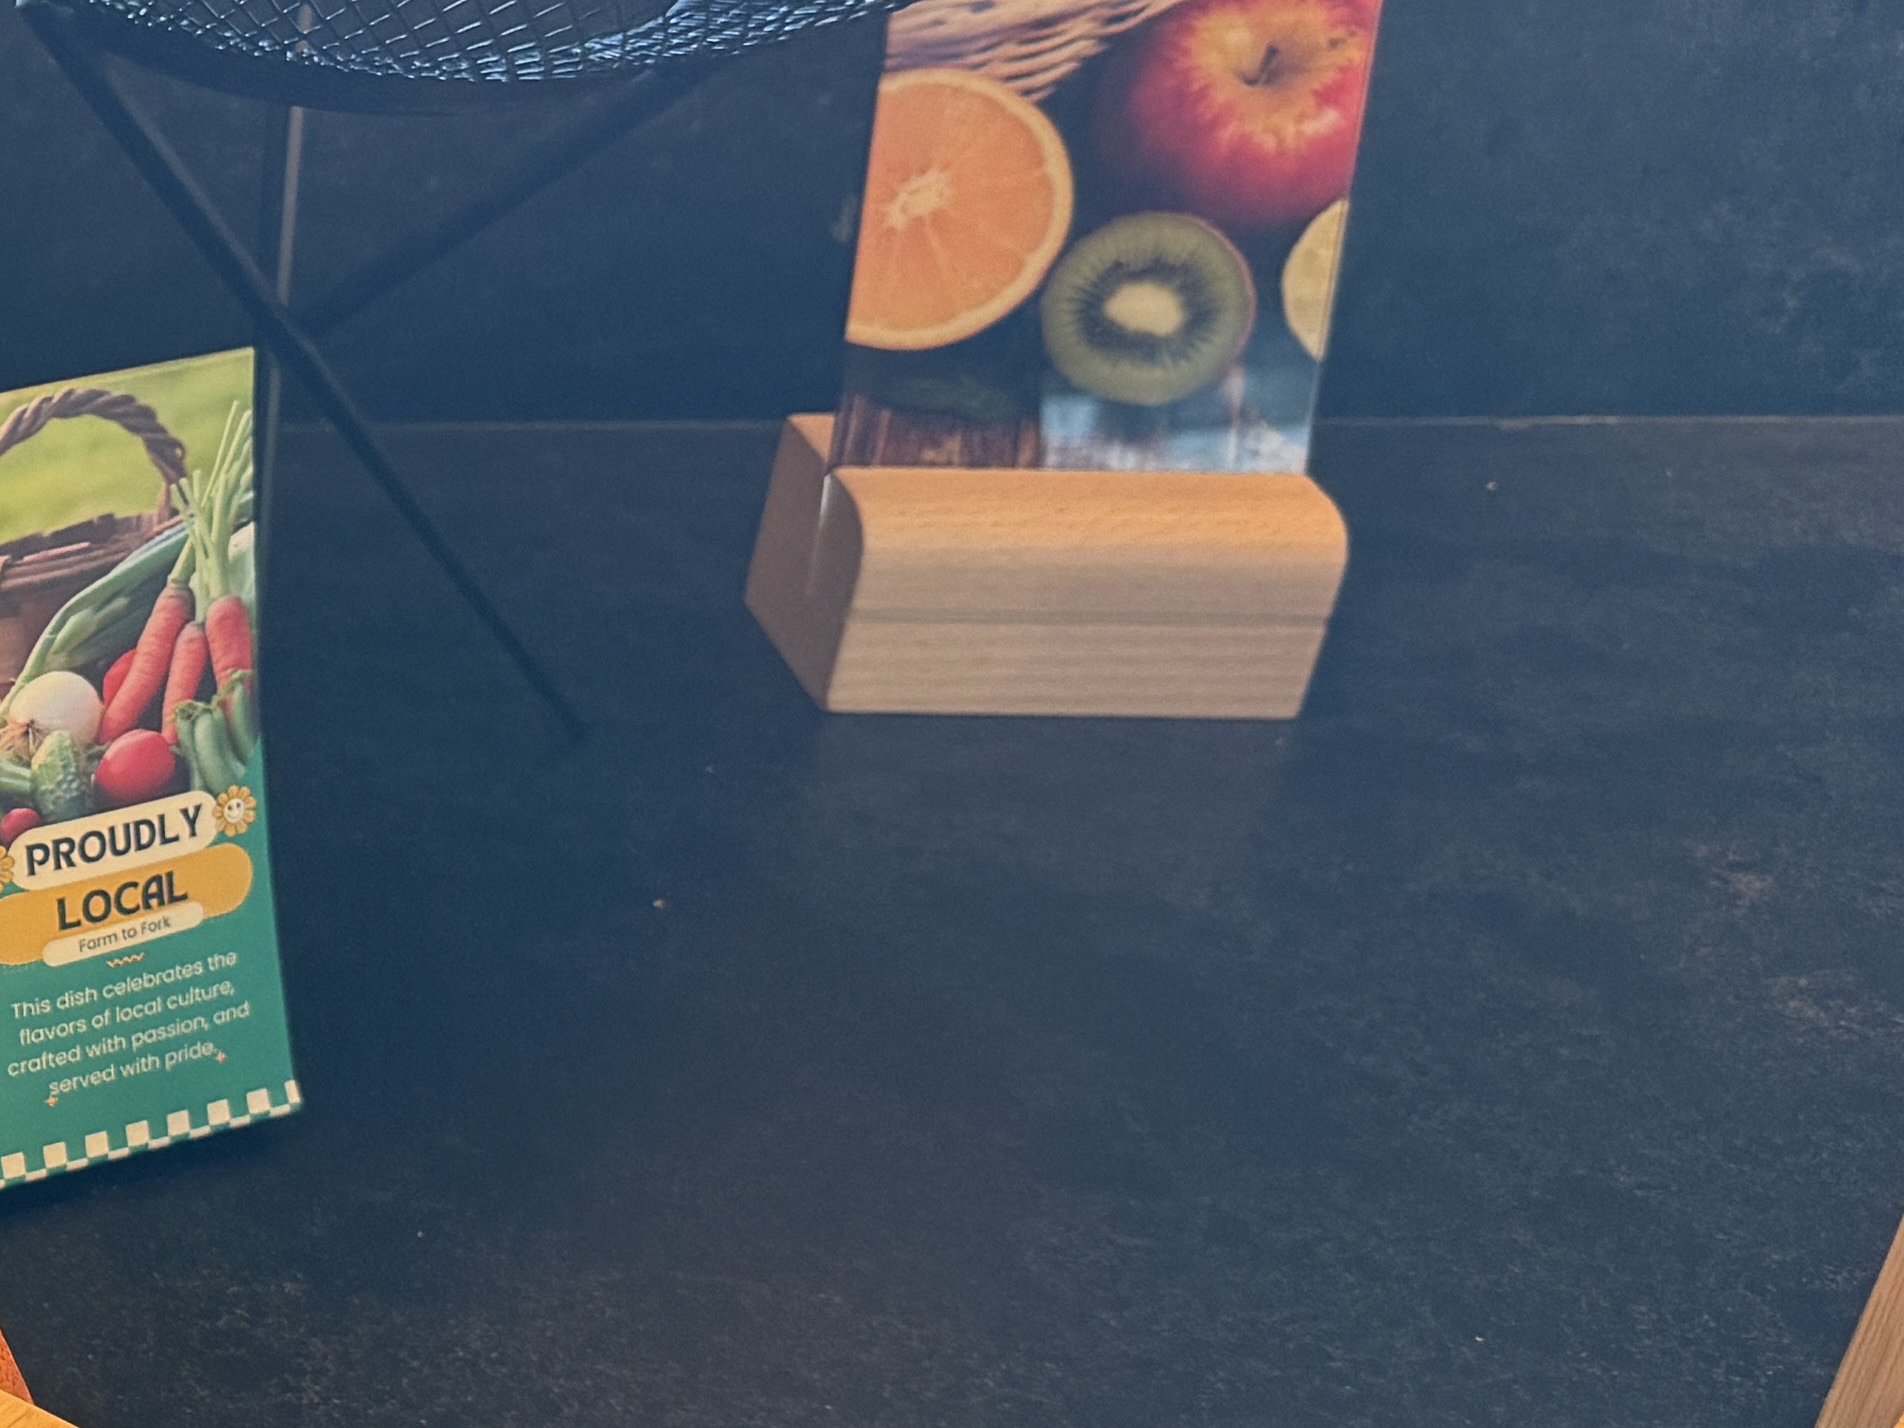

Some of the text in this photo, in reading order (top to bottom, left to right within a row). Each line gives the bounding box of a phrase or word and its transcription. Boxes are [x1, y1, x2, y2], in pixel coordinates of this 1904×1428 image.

[24, 802, 203, 877] PROUDLY
[56, 870, 189, 932] LOCAL
[78, 914, 172, 953] Farm to Fork
[11, 951, 238, 1019] This dish celebrates the
[18, 980, 236, 1047] flavors of local culture,
[7, 1000, 253, 1077] crafted with passion, and
[48, 1063, 116, 1097] served
[119, 1052, 161, 1077] with
